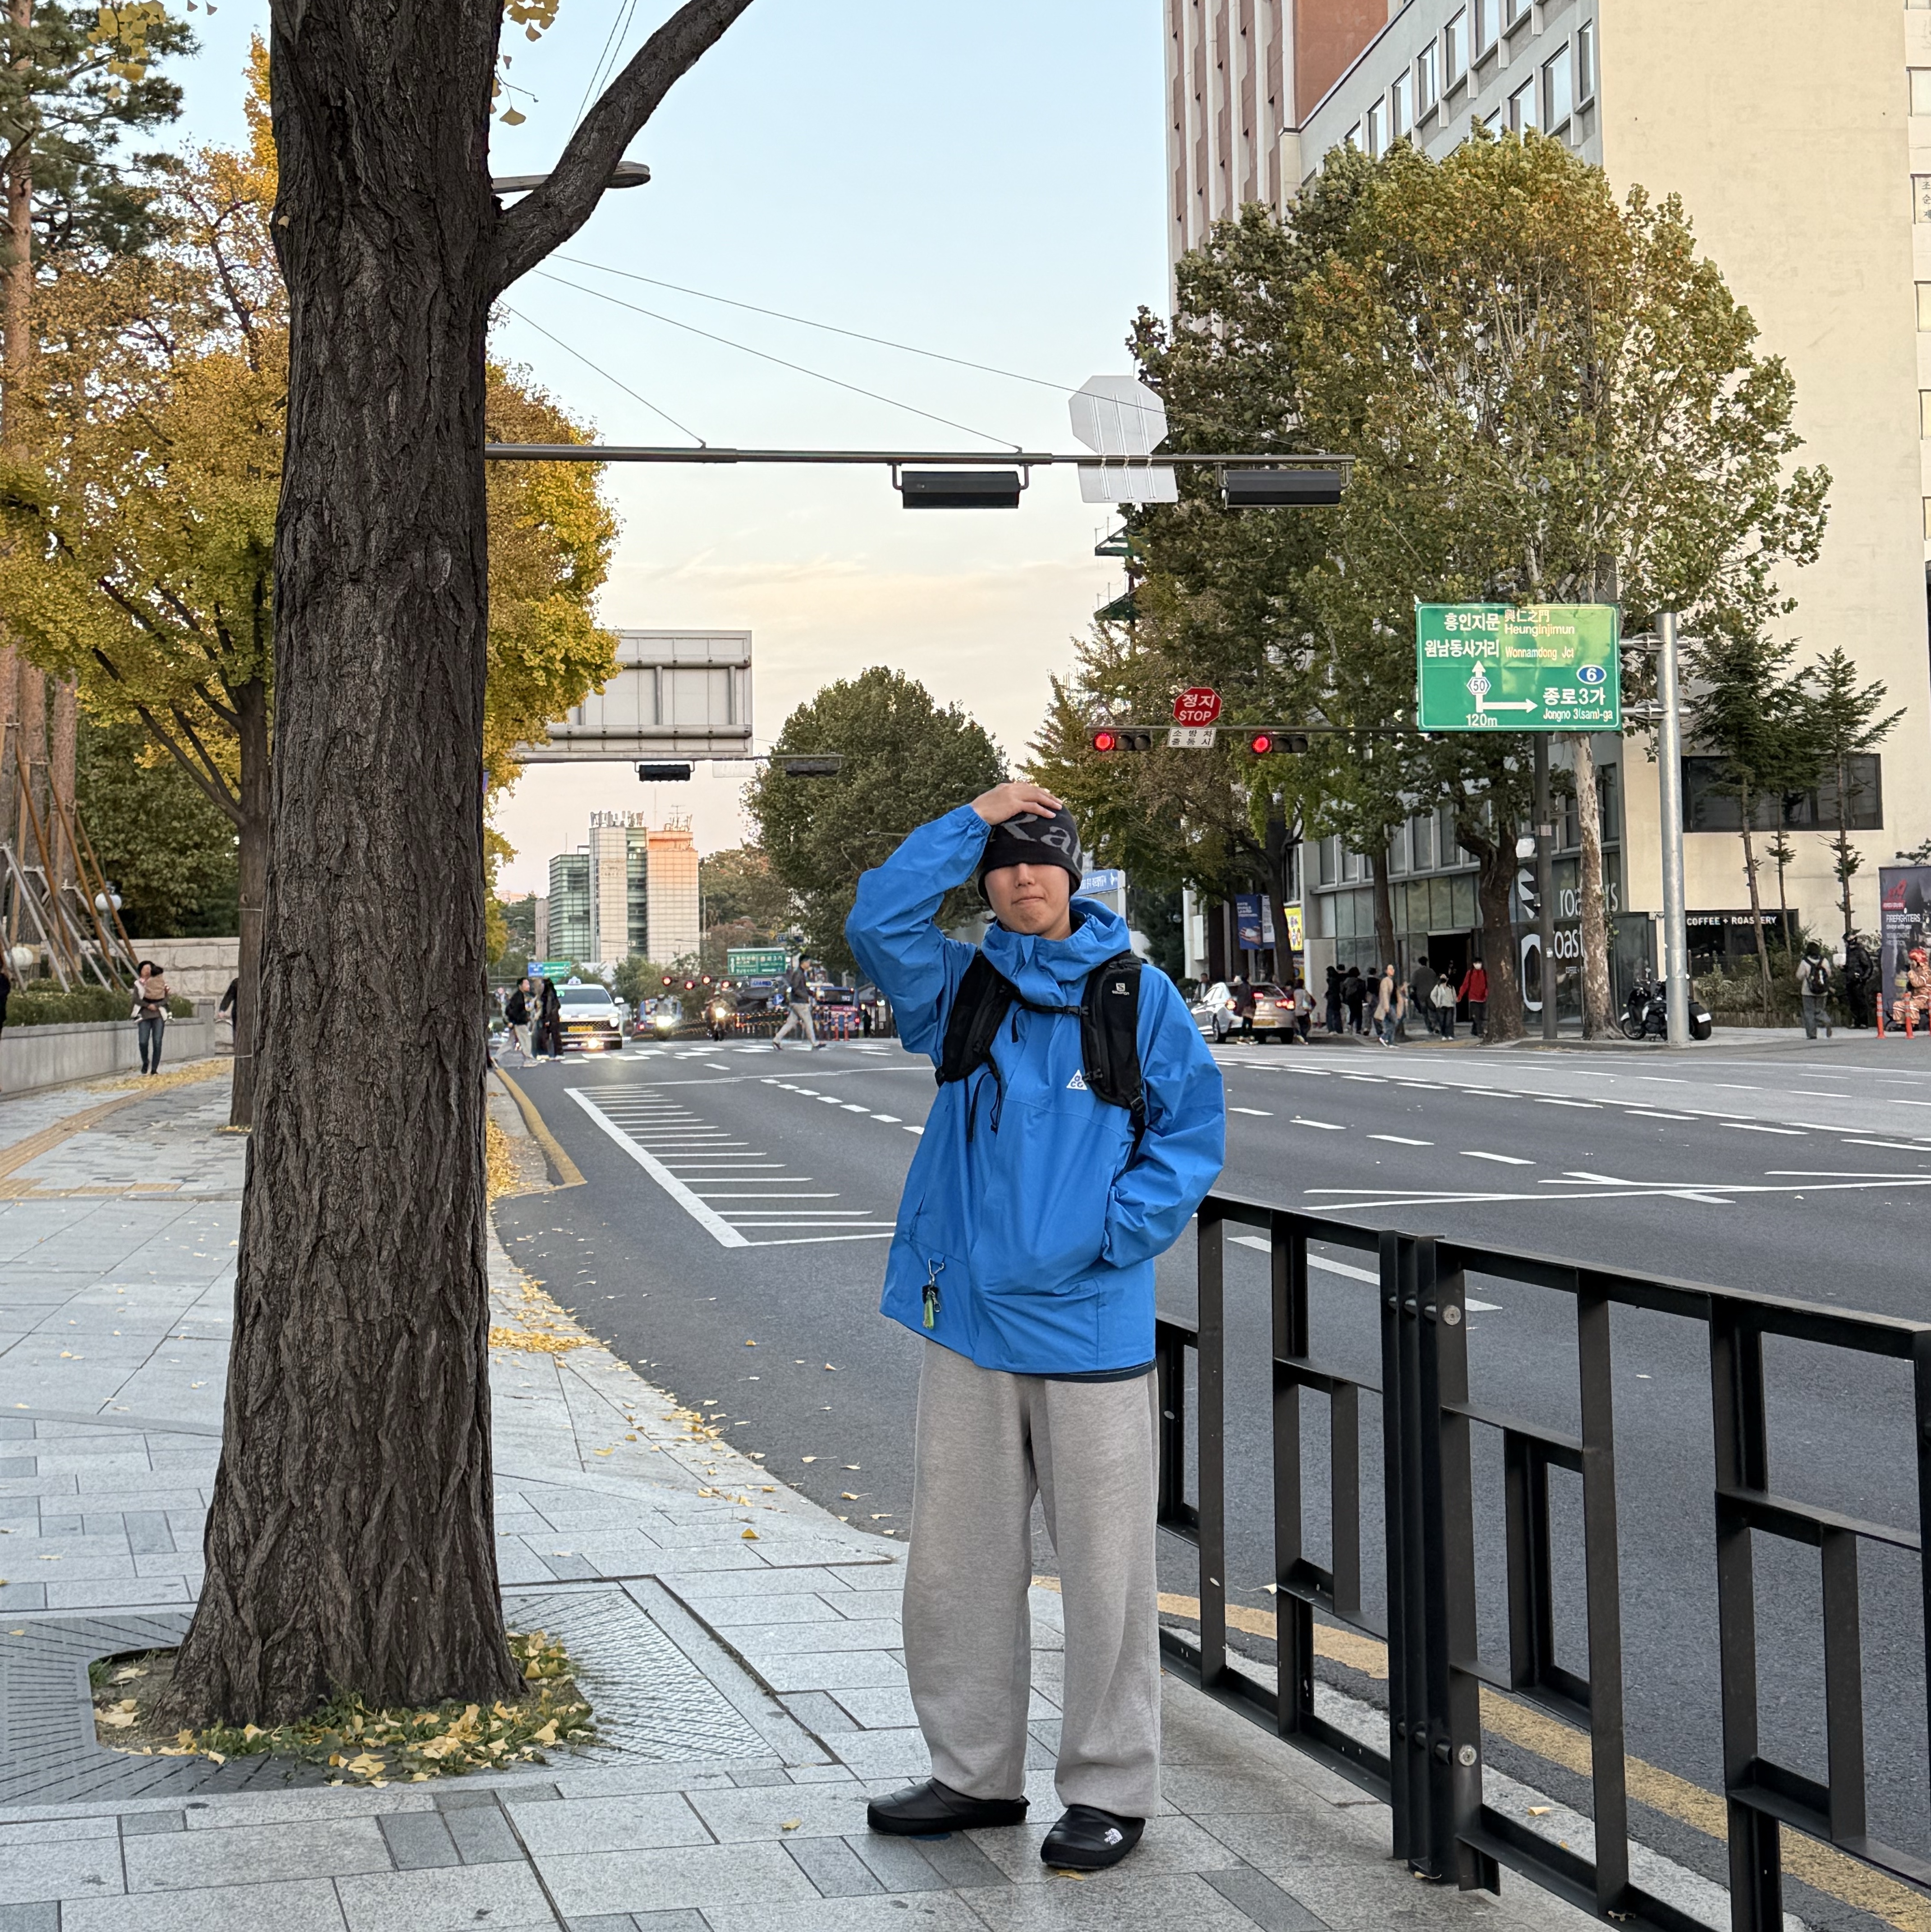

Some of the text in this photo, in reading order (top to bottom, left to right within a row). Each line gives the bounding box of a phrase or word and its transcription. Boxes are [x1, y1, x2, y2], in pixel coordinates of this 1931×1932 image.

[1444, 612, 1500, 631] 흥인지문
[1504, 609, 1550, 623] 興仁之門
[1504, 624, 1575, 637] Heunginjimun
[1425, 639, 1499, 658] 원남동사거리
[1505, 646, 1574, 660] Wonnamdong Jct
[1587, 668, 1597, 682] 6
[1473, 680, 1486, 691] 50
[1182, 694, 1215, 708] 정지
[1543, 687, 1605, 706] 종로3가
[1179, 710, 1211, 721] STOP
[1467, 715, 1498, 727] 120m
[1543, 708, 1613, 722] Jongno 3(sam)-ga
[1687, 917, 1720, 926] COFFEE
[1732, 916, 1777, 925] ROASERY
